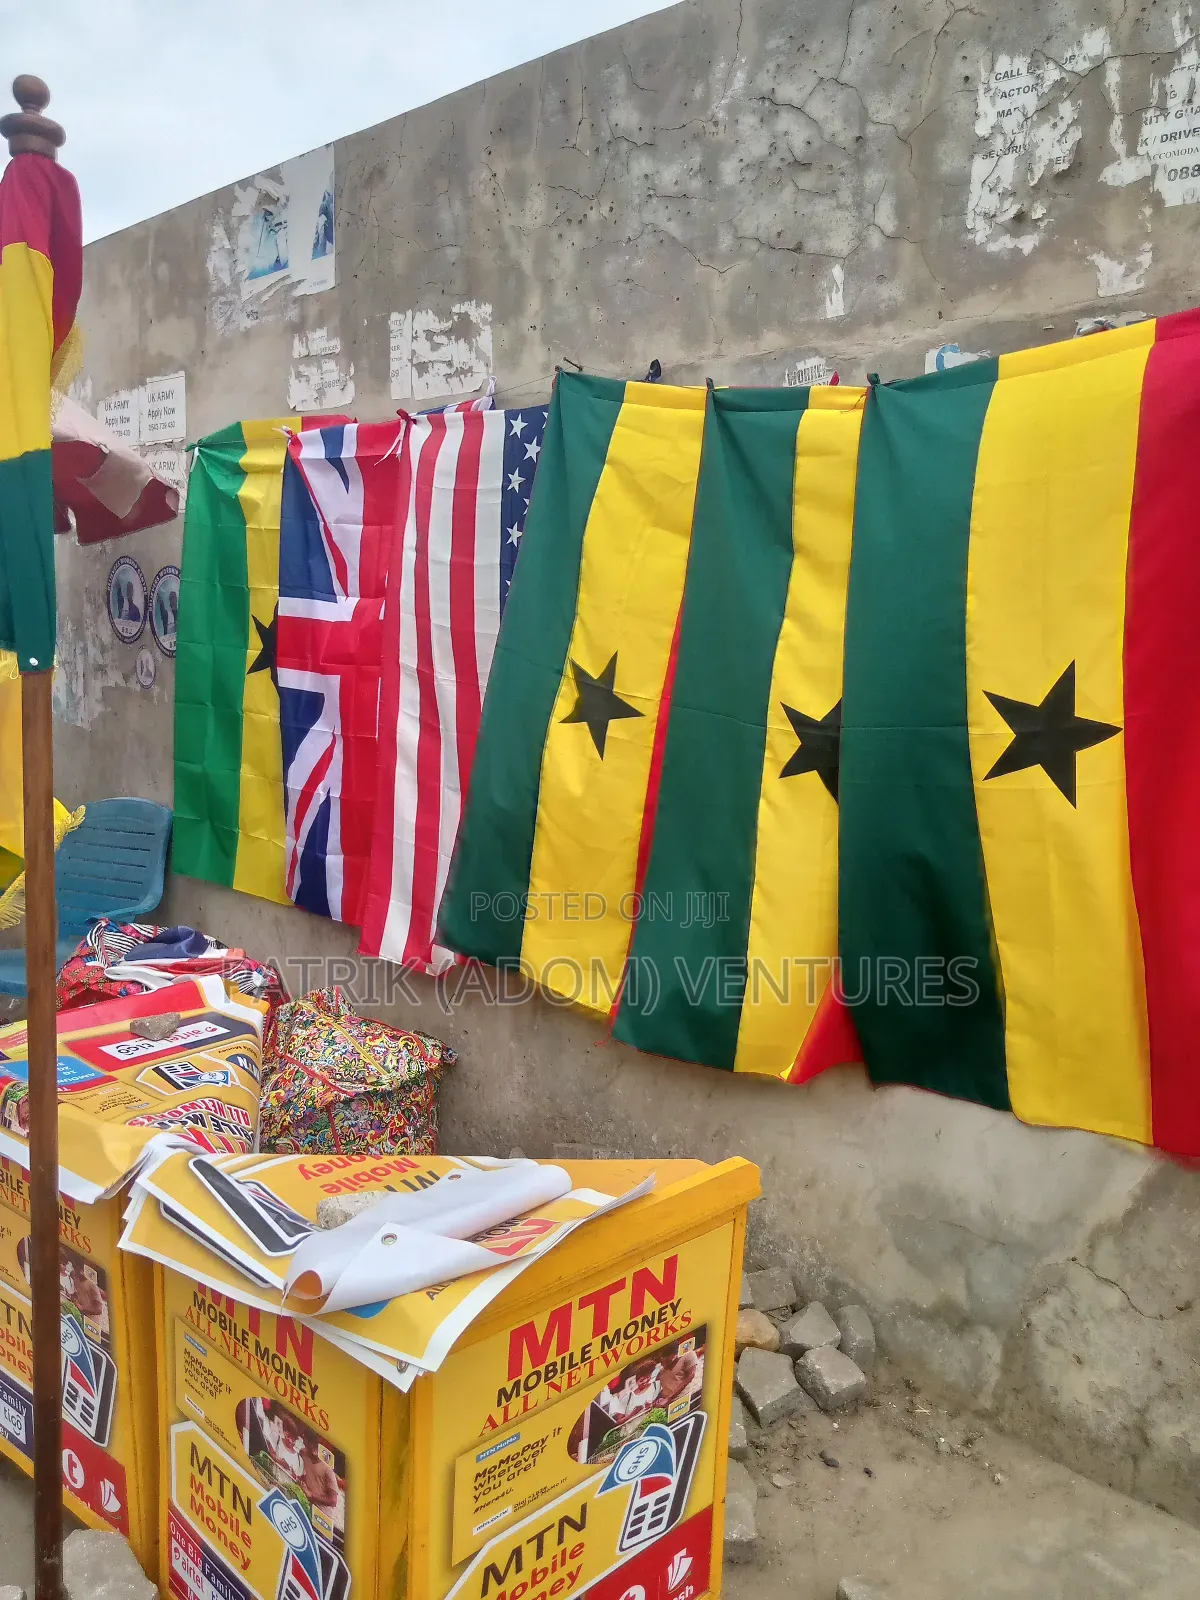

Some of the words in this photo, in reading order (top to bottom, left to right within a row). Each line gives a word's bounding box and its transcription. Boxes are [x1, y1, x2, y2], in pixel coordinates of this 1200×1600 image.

[995, 68, 1022, 82] CALL
[105, 402, 113, 412] UK
[114, 400, 130, 410] ARMY
[148, 393, 157, 404] UK
[158, 390, 175, 401] ARMY
[148, 409, 162, 419] Apply
[163, 406, 176, 416] Now
[105, 417, 119, 427] Apply
[120, 415, 131, 423] Now
[158, 461, 176, 474] ARMY
[226, 1103, 251, 1128] ALL
[318, 1157, 421, 1195] Mobile
[507, 1253, 679, 1382] MTN
[193, 1291, 250, 1350] MOBILE
[255, 1339, 320, 1401] MONEY
[496, 1342, 593, 1408] MOBILE
[600, 1298, 682, 1354] MONEY
[184, 1348, 224, 1388] MoMoPay
[184, 1305, 217, 1343] ALL
[219, 1331, 330, 1433] NETWORKS
[184, 1366, 199, 1382] you
[184, 1358, 222, 1395] wherever
[478, 1393, 538, 1437] ALL
[544, 1308, 693, 1401] NETWORKS
[4, 1407, 23, 1436] tigo
[473, 1434, 550, 1483] MoMoPay
[473, 1444, 548, 1492] wherever
[627, 1446, 650, 1475] GHS
[190, 1441, 252, 1526] MTN
[473, 1479, 502, 1504] you
[506, 1458, 537, 1483] are!
[190, 1473, 252, 1549] Mobile
[279, 1516, 298, 1534] GHS
[169, 1521, 186, 1549] One
[188, 1536, 203, 1570] Big
[190, 1494, 252, 1571] Money
[480, 1502, 588, 1599] MTN
[181, 1557, 205, 1593] airtel
